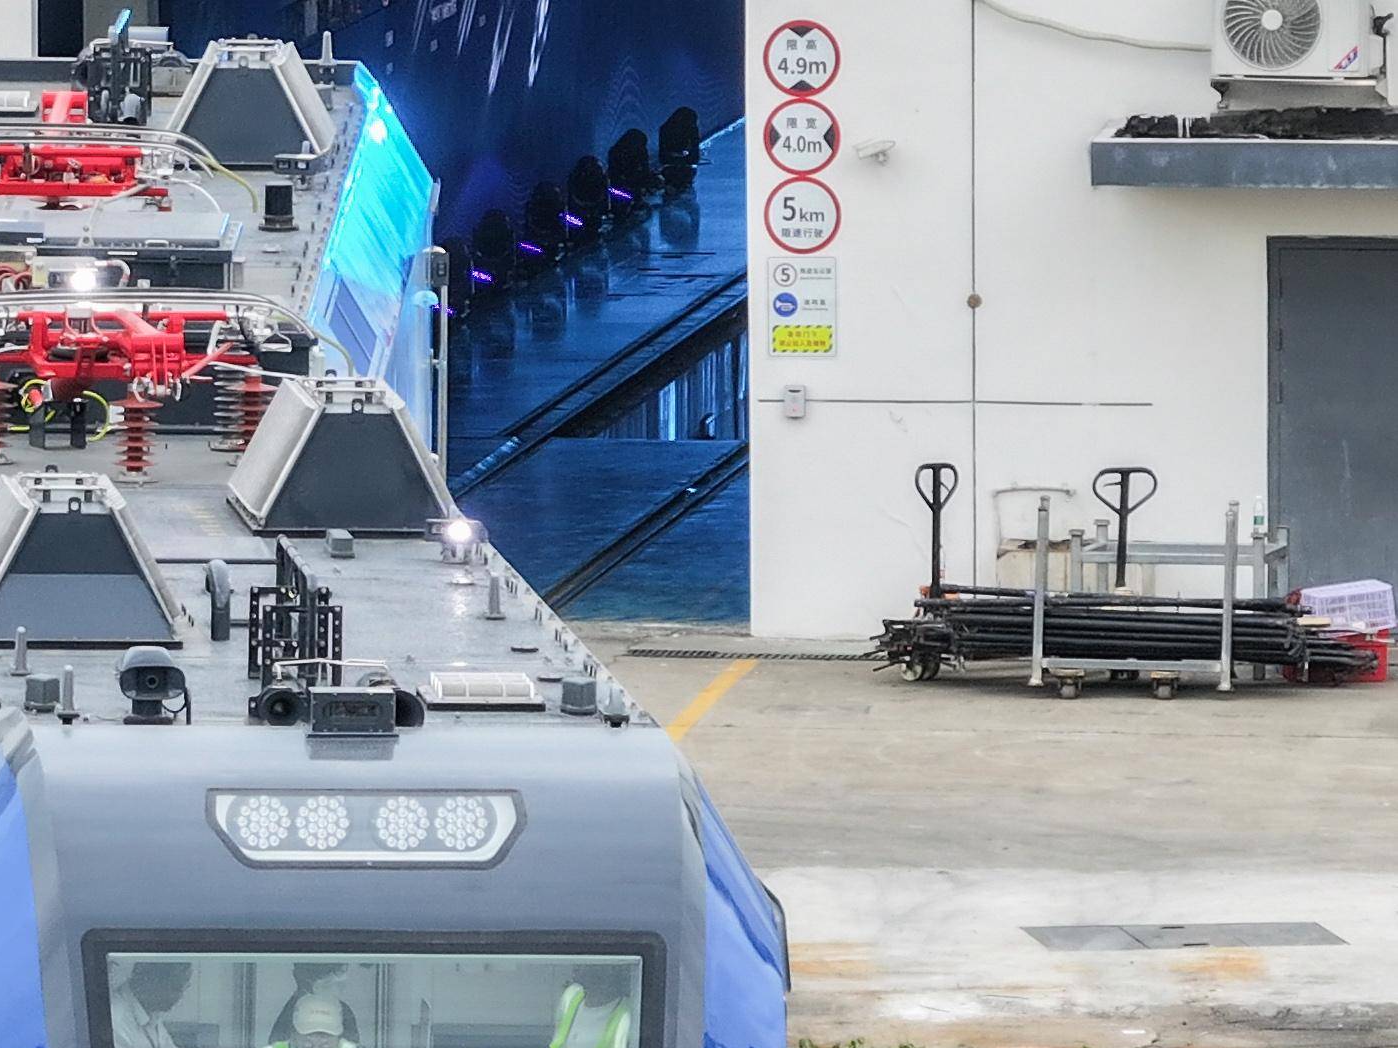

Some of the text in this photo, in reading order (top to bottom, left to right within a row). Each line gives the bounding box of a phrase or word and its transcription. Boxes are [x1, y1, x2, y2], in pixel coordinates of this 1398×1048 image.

[786, 39, 818, 51] 限高
[777, 57, 827, 75] 4.9m
[786, 117, 818, 130] 限宽
[782, 135, 822, 153] 4.0m
[780, 267, 791, 282] 5
